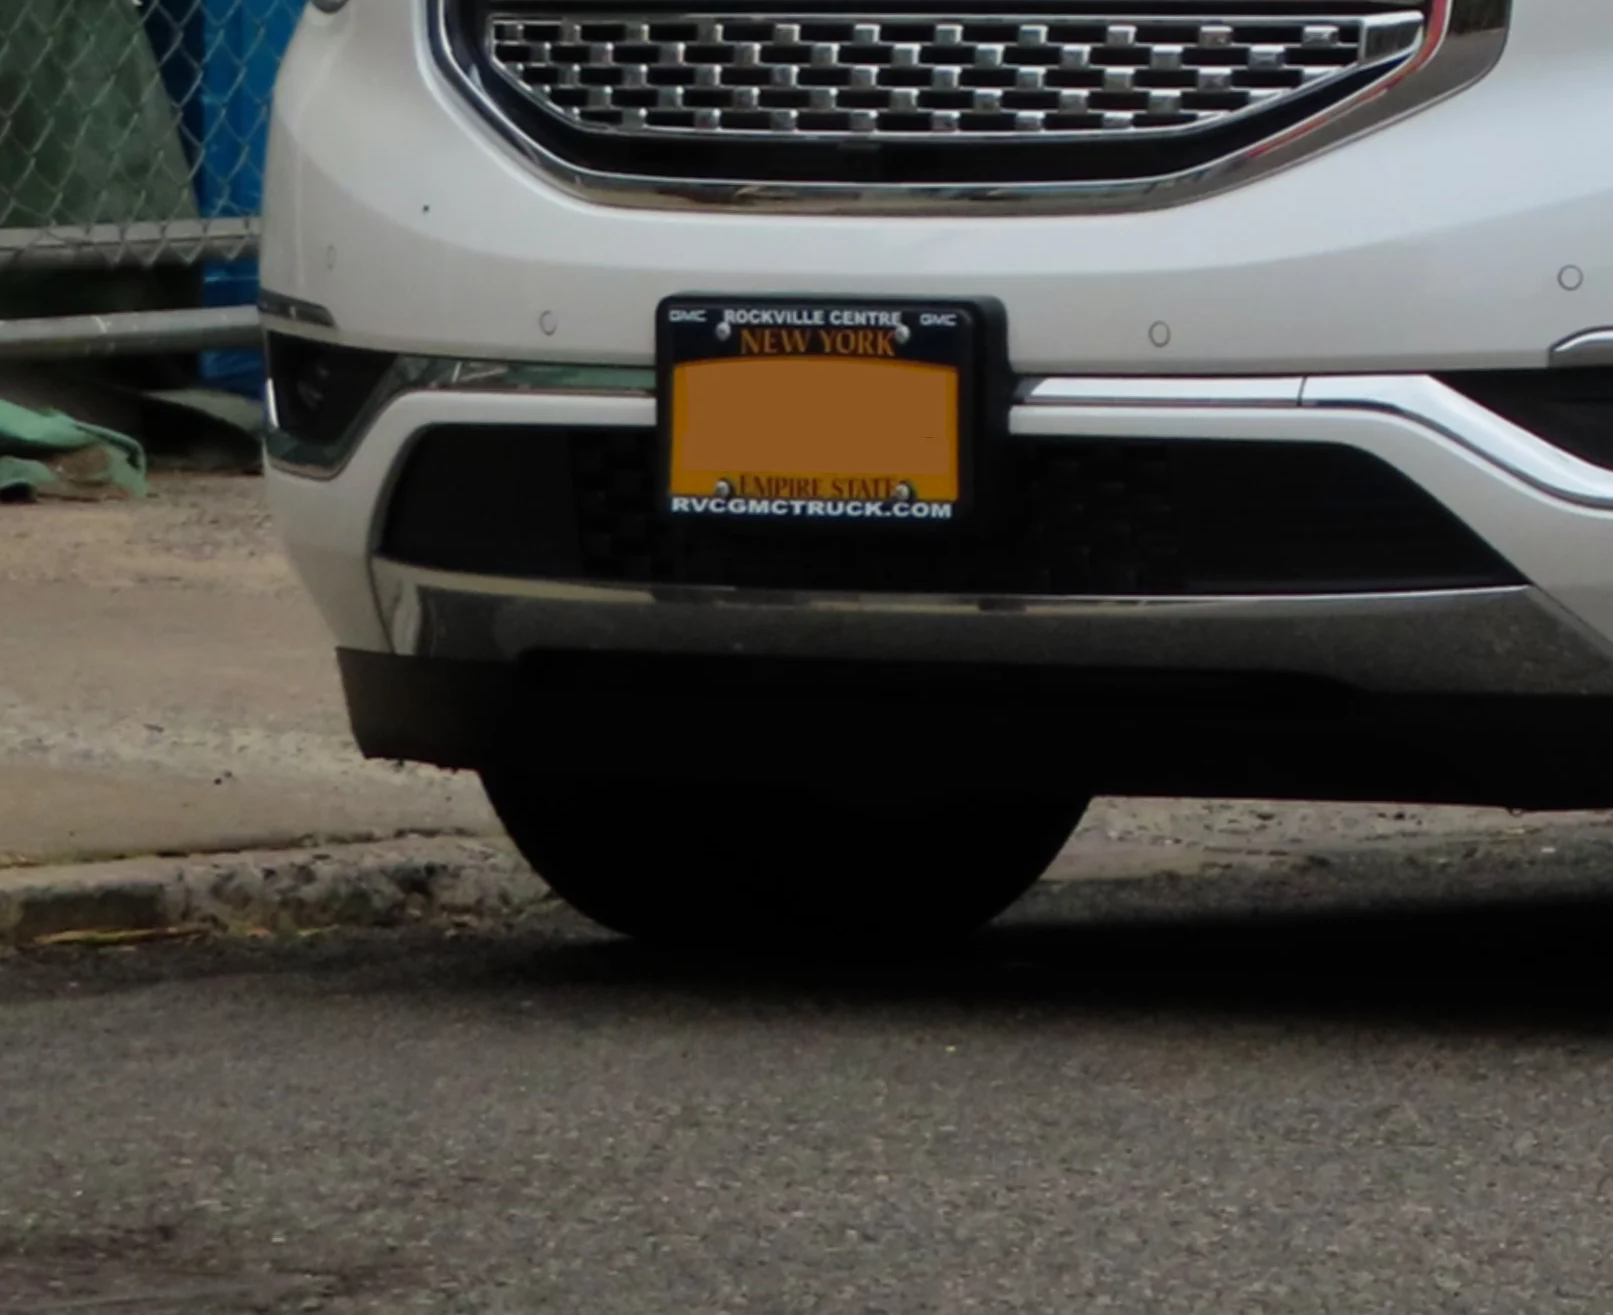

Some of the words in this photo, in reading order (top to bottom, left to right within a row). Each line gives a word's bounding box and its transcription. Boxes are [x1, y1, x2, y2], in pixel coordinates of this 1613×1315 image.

[668, 308, 707, 323] GMC
[723, 308, 826, 326] ROCKVILLE
[829, 310, 902, 327] CENTRE
[919, 313, 958, 327] GMC
[740, 328, 812, 355] NEW
[818, 329, 895, 357] YORK
[738, 474, 823, 499] EMPIRE
[831, 476, 898, 500] STATE
[671, 496, 952, 519] RVCGMCTRUCK.COM
